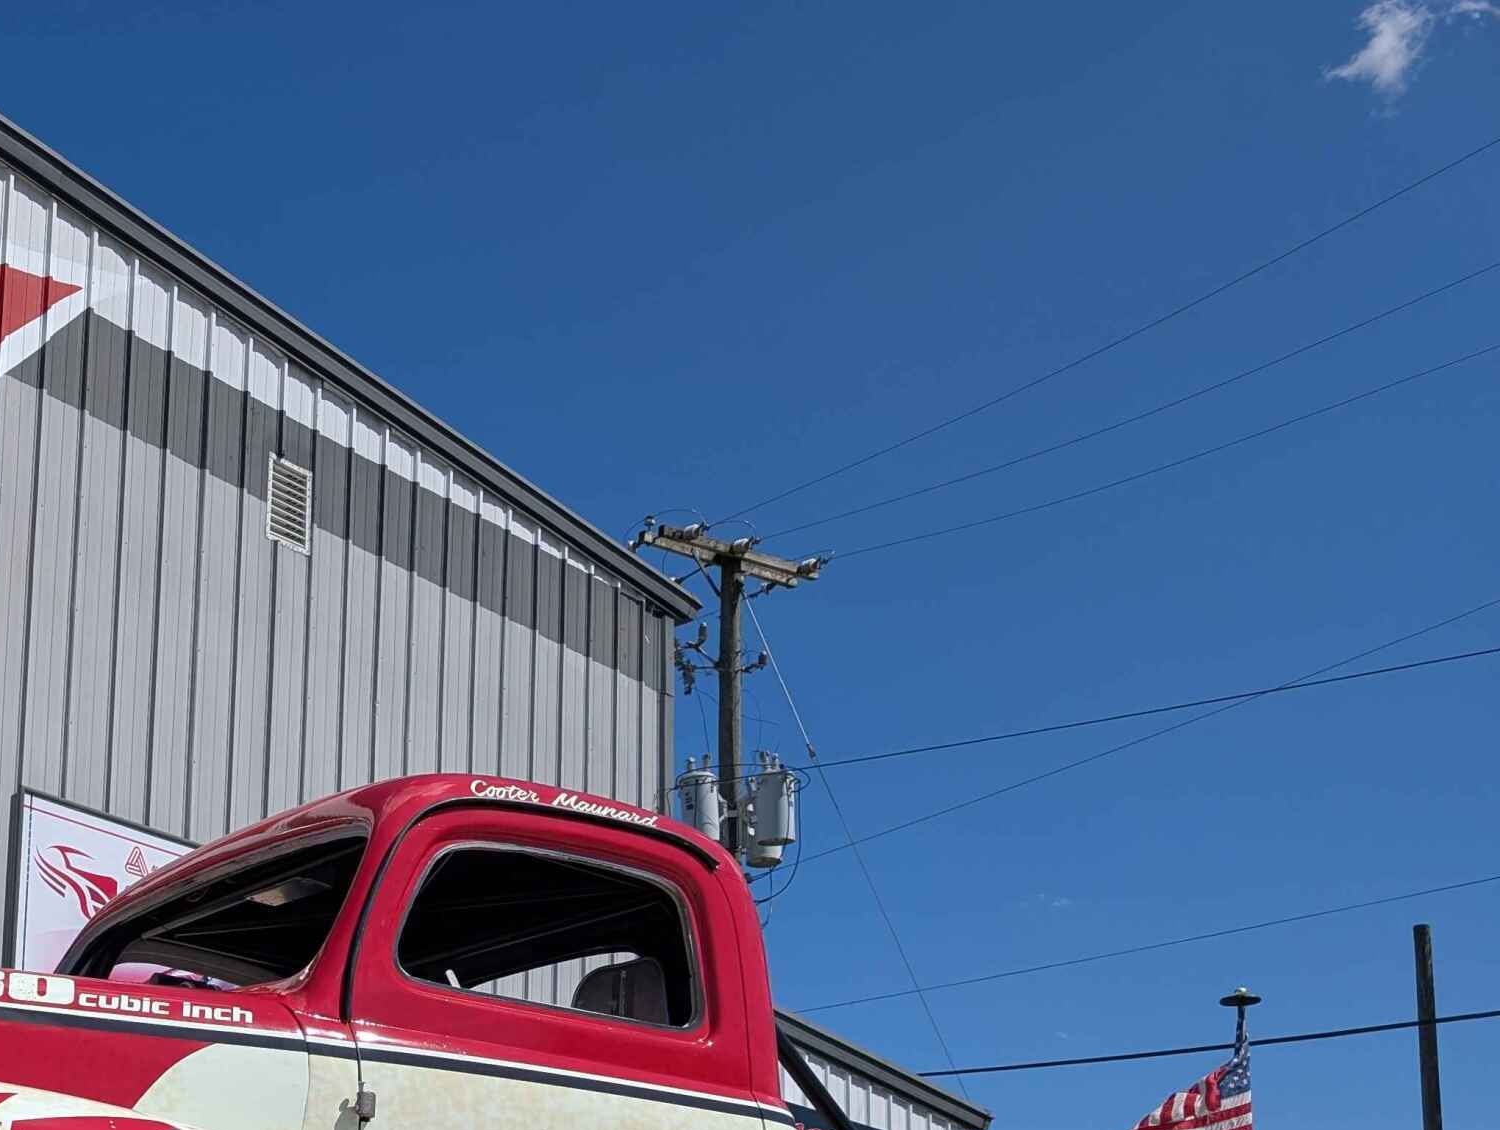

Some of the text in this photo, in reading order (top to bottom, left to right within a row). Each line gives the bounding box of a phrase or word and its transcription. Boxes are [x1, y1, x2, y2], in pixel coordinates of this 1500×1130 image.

[470, 779, 540, 804] Cooter
[79, 992, 170, 1016] cubic
[181, 1000, 253, 1024] inch
